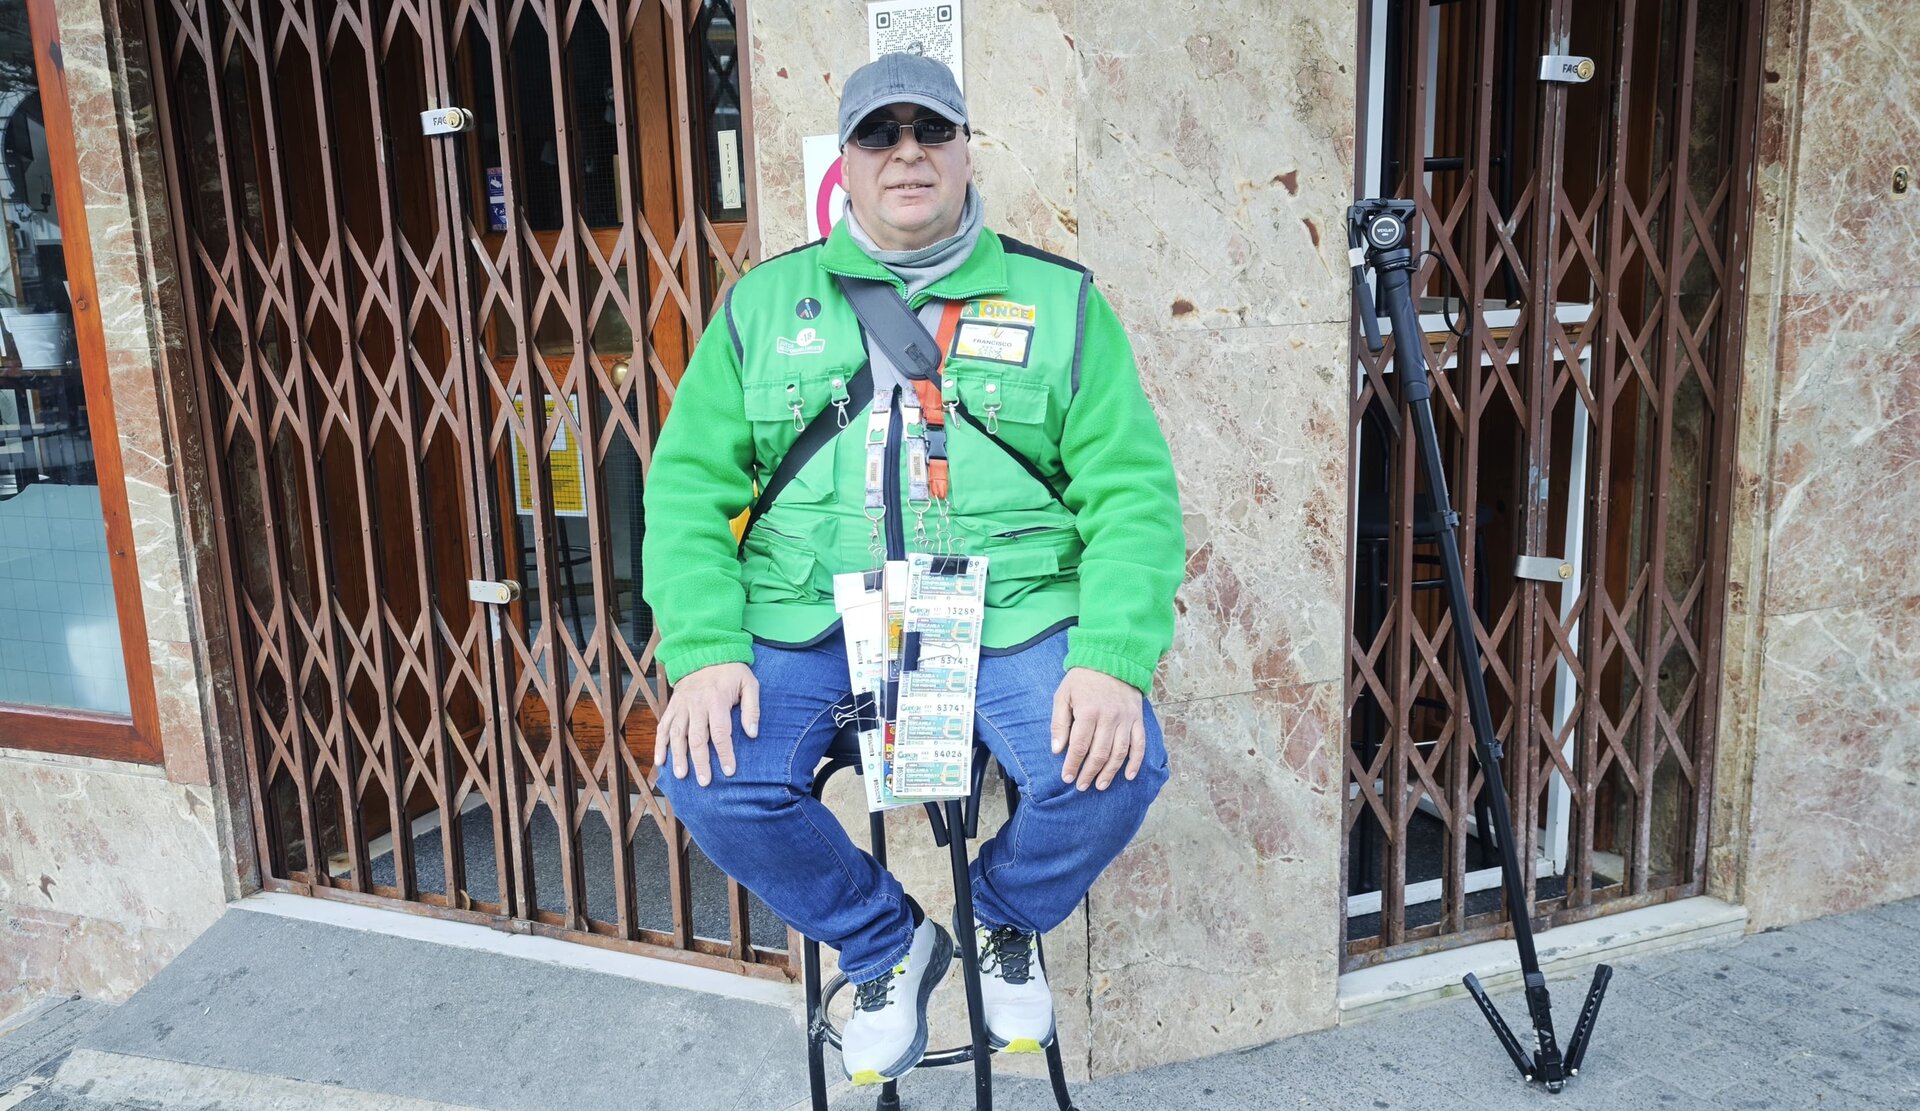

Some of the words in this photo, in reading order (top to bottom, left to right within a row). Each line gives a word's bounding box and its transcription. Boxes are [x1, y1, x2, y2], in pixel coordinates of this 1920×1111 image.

[983, 303, 1030, 320] ONCE
[973, 338, 1013, 348] FRANCISCO
[947, 607, 975, 615] 13289
[937, 704, 965, 712] 83741
[934, 750, 962, 758] 84026
